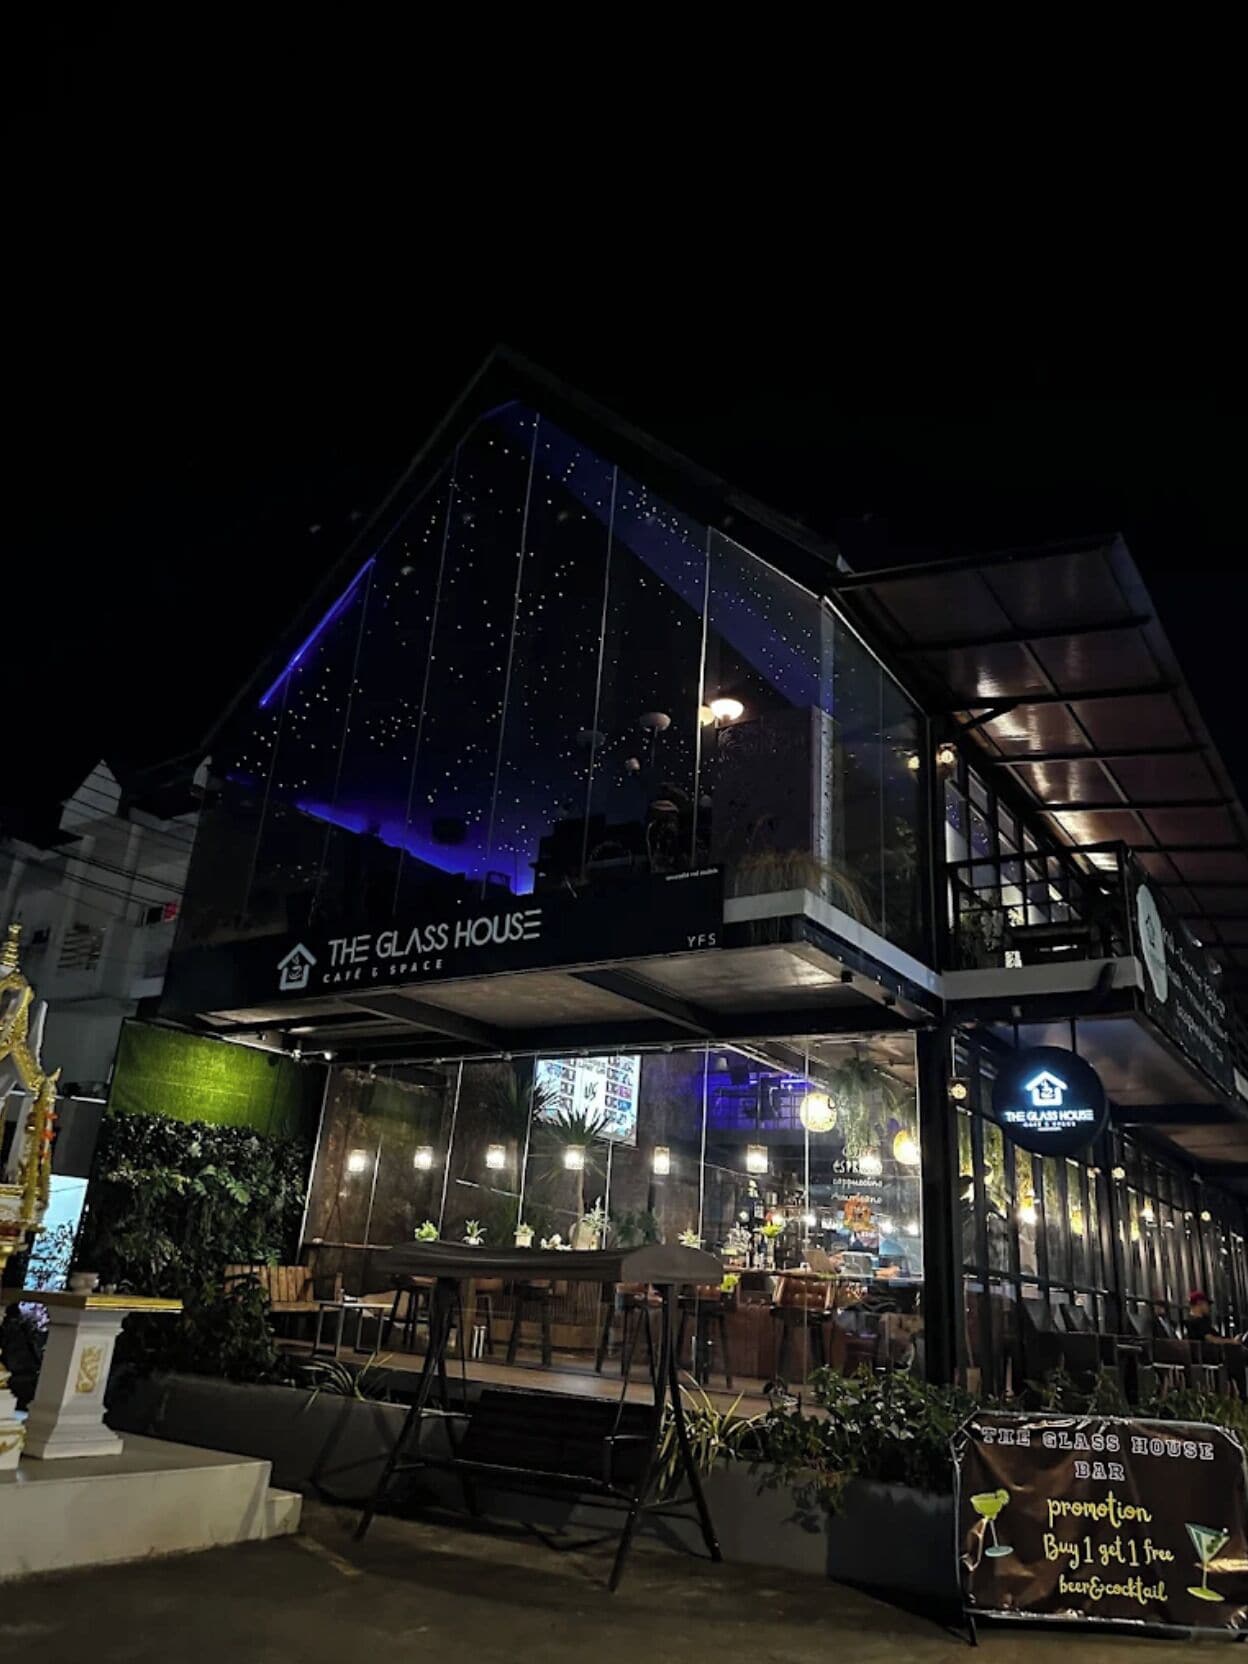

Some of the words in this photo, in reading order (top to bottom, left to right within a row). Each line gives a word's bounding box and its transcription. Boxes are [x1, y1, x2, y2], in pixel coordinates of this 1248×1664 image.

[328, 935, 371, 967] THE
[376, 924, 449, 958] GLASS
[454, 909, 543, 949] HOUSE
[687, 932, 717, 948] YFS
[390, 958, 444, 976] SPACE
[1004, 1111, 1025, 1122] THE
[1027, 1110, 1058, 1121] GLASS
[1059, 1109, 1094, 1120] HOUSE
[981, 1427, 1031, 1446] THE
[1042, 1432, 1120, 1451] GLASS
[1131, 1436, 1214, 1460] HOUSE
[1074, 1461, 1125, 1481] BAR
[1047, 1490, 1152, 1528] promotion
[1043, 1533, 1080, 1569] Buy
[1083, 1536, 1094, 1563] 1
[1098, 1535, 1126, 1566] get
[1127, 1539, 1140, 1567] 1
[1144, 1538, 1175, 1565] free
